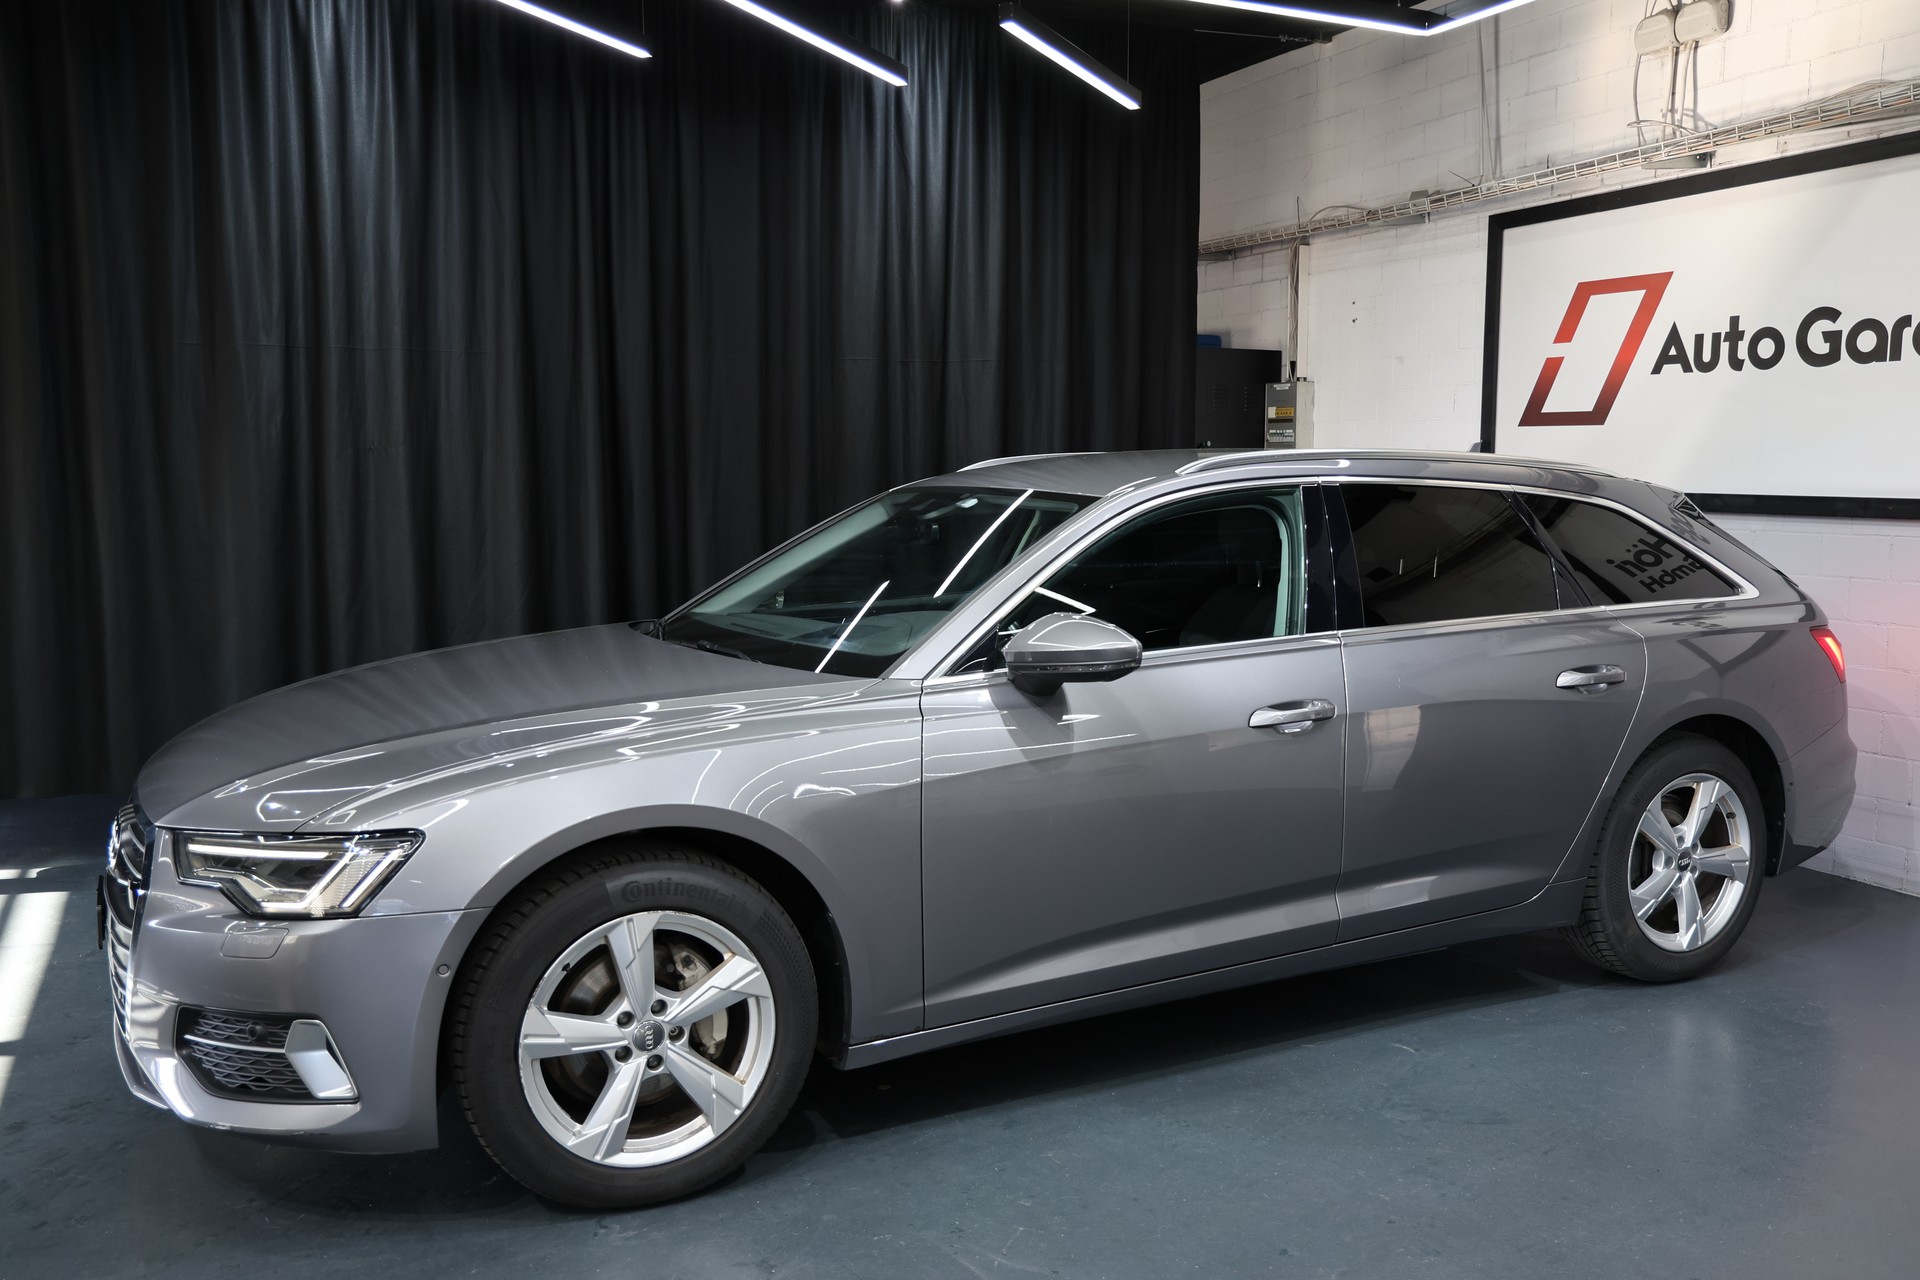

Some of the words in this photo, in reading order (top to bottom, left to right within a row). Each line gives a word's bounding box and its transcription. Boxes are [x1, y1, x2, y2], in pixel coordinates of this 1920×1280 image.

[1650, 315, 1786, 375] Auto
[1795, 306, 1920, 368] Gar
[621, 877, 737, 908] Continental
